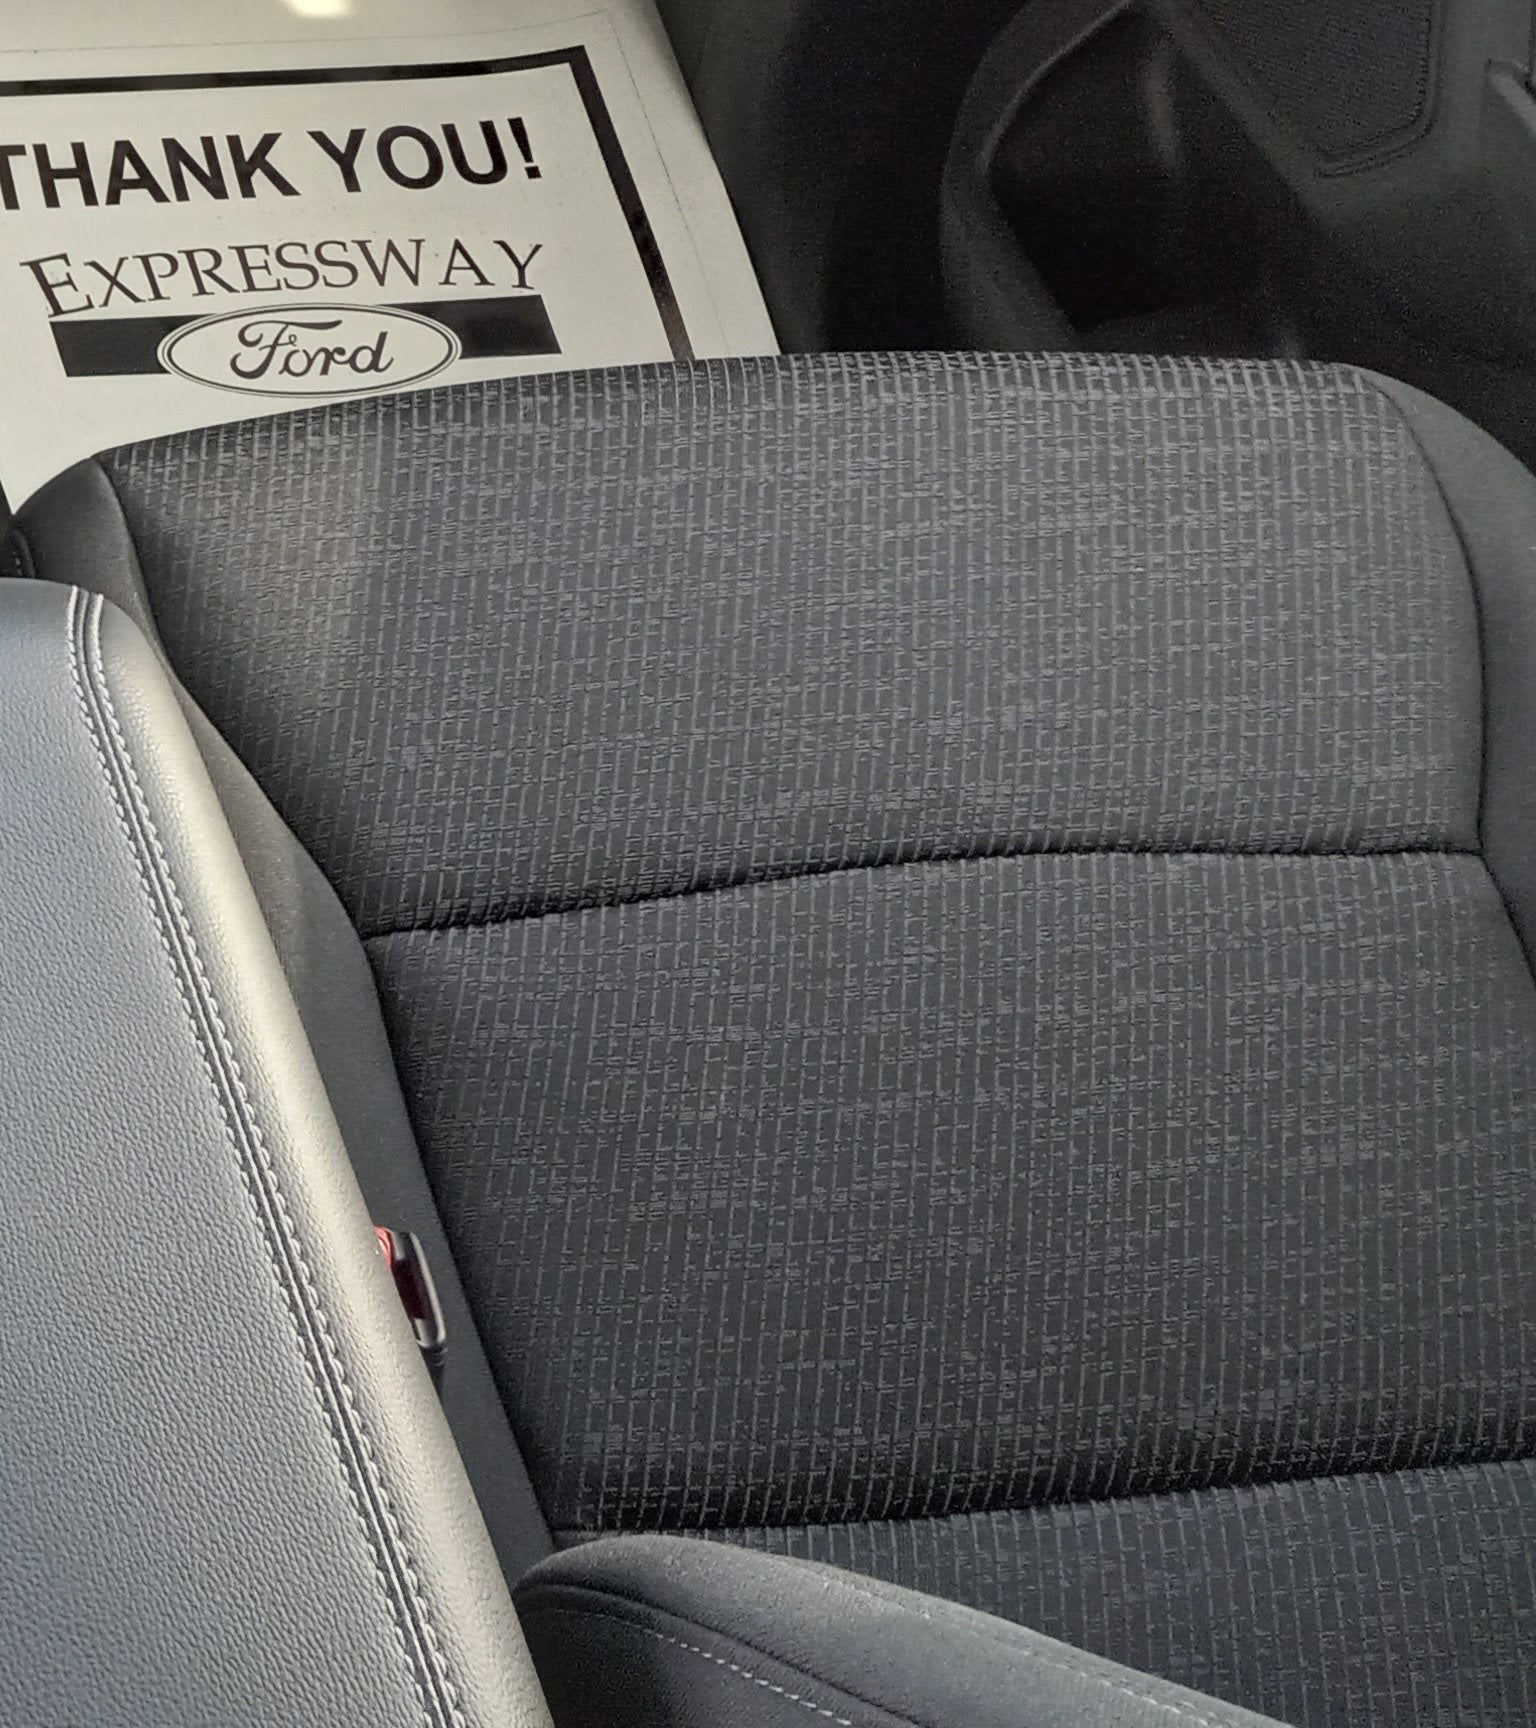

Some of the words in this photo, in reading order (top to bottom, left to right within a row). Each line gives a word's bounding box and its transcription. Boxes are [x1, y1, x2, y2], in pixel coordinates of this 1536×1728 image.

[307, 116, 543, 193] YOU!
[19, 238, 543, 318] EXPRESSWAY
[230, 319, 395, 380] Ford
